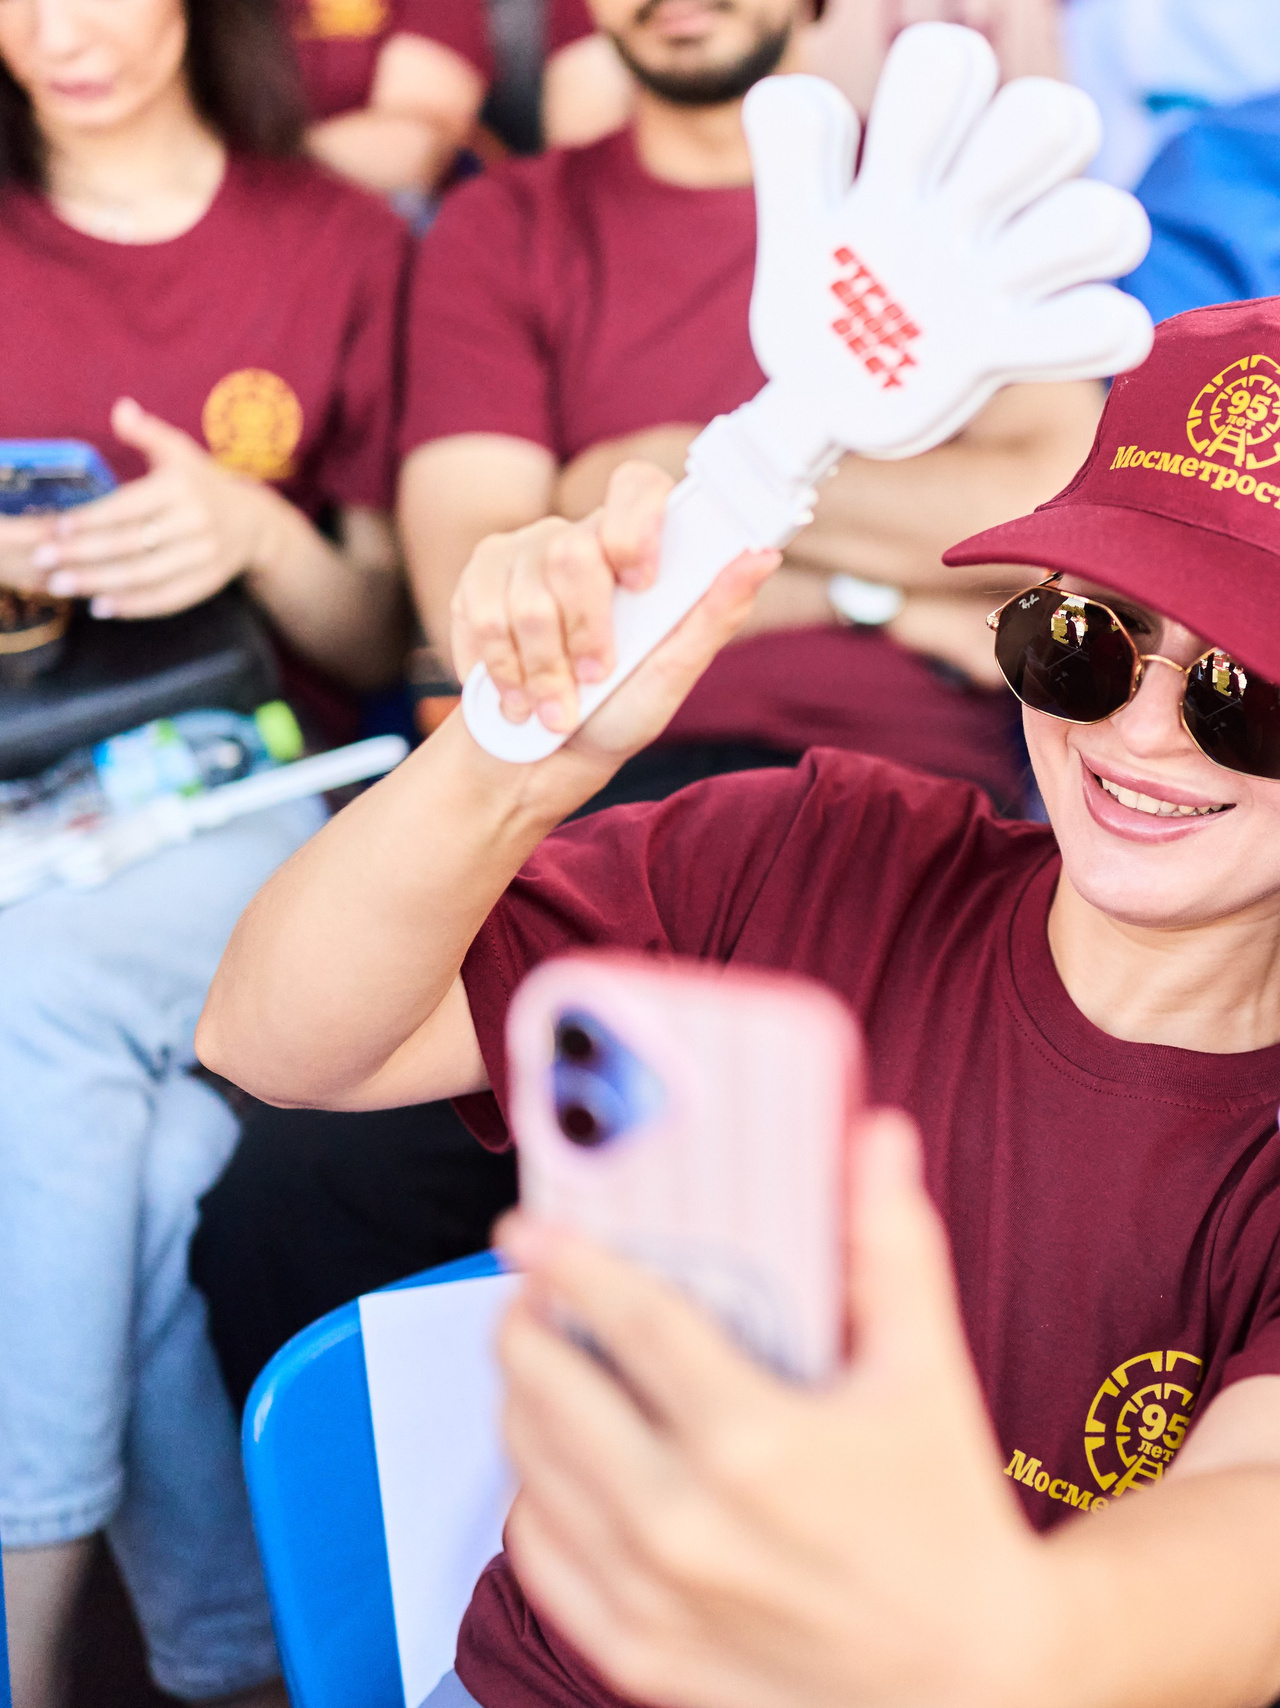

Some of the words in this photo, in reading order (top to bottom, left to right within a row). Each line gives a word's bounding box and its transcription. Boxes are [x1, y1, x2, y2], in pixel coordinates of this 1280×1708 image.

[1227, 389, 1272, 422] 95
[1225, 414, 1256, 430] лет
[1138, 1403, 1191, 1450] 95
[1137, 1439, 1175, 1463] лет
